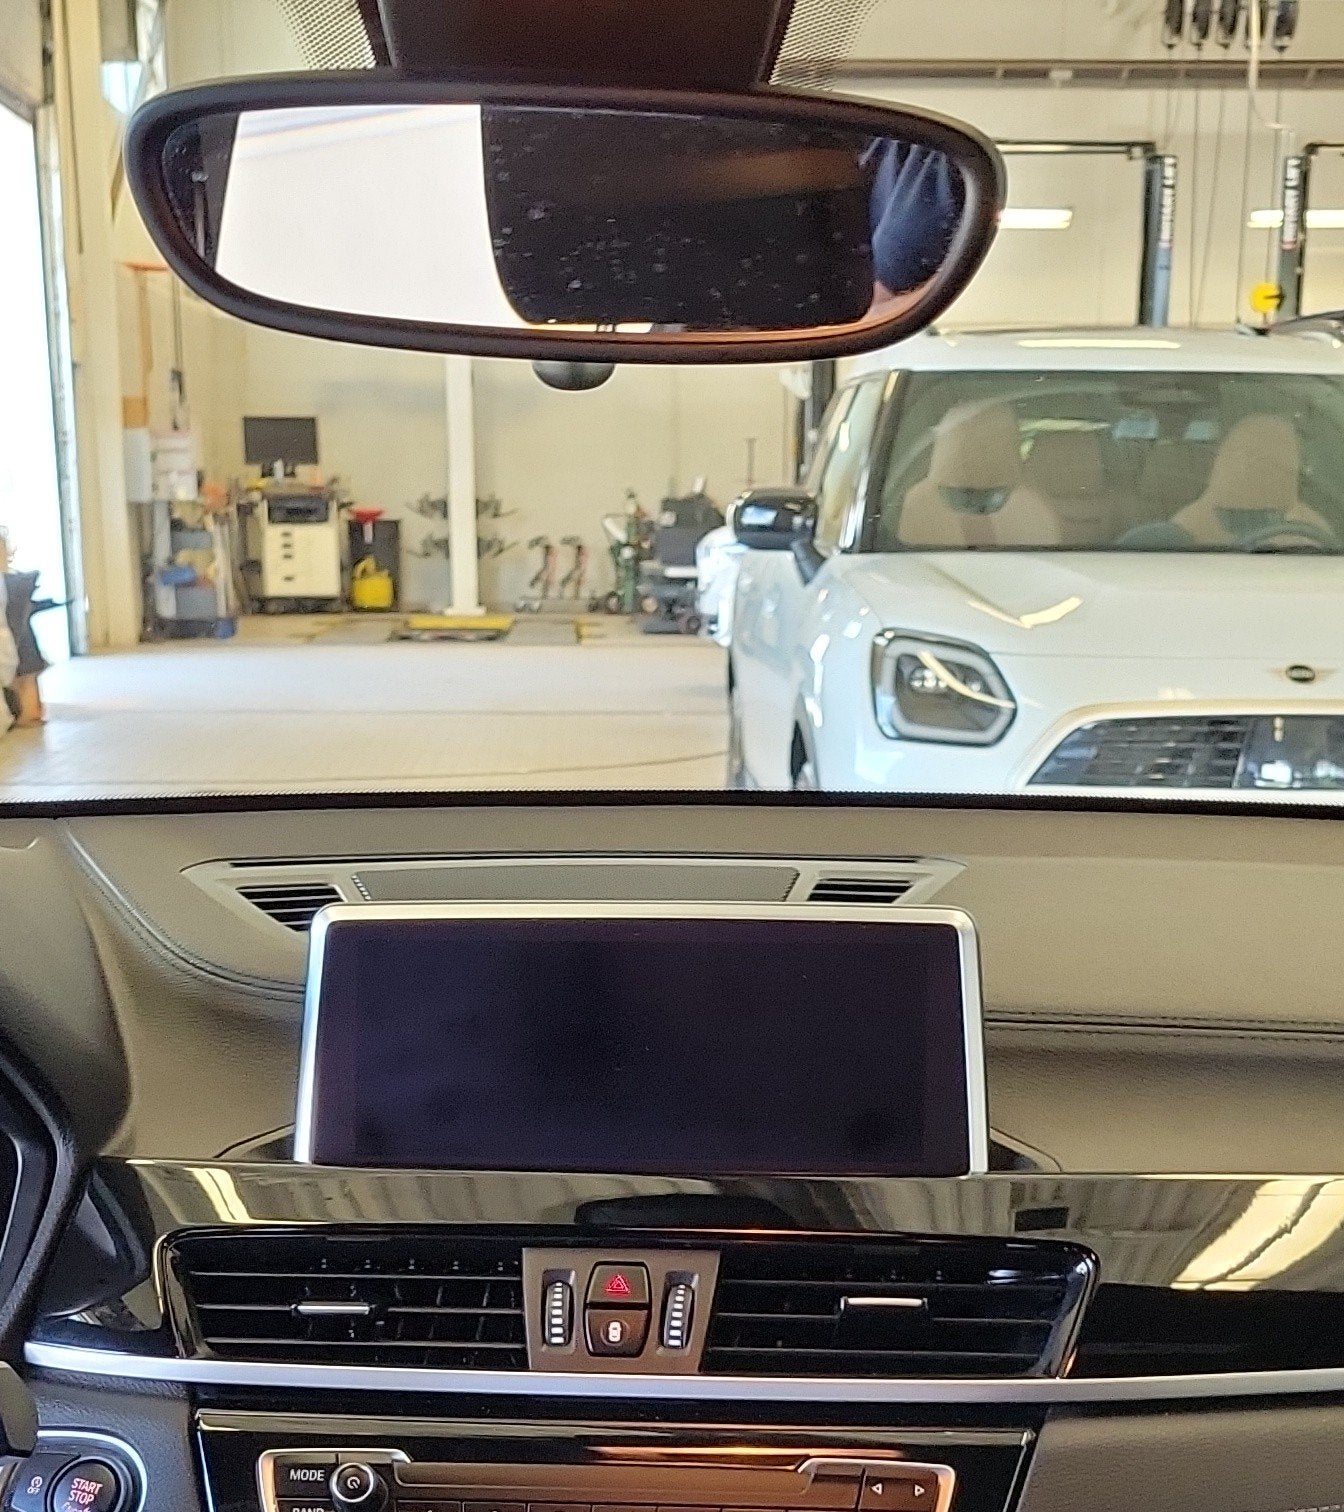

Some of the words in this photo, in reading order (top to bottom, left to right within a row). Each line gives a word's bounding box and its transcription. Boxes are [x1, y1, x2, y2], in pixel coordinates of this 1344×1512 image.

[289, 1469, 325, 1482] MODE
[26, 1487, 40, 1495] OFF
[71, 1477, 103, 1495] START
[68, 1489, 95, 1505] STOP
